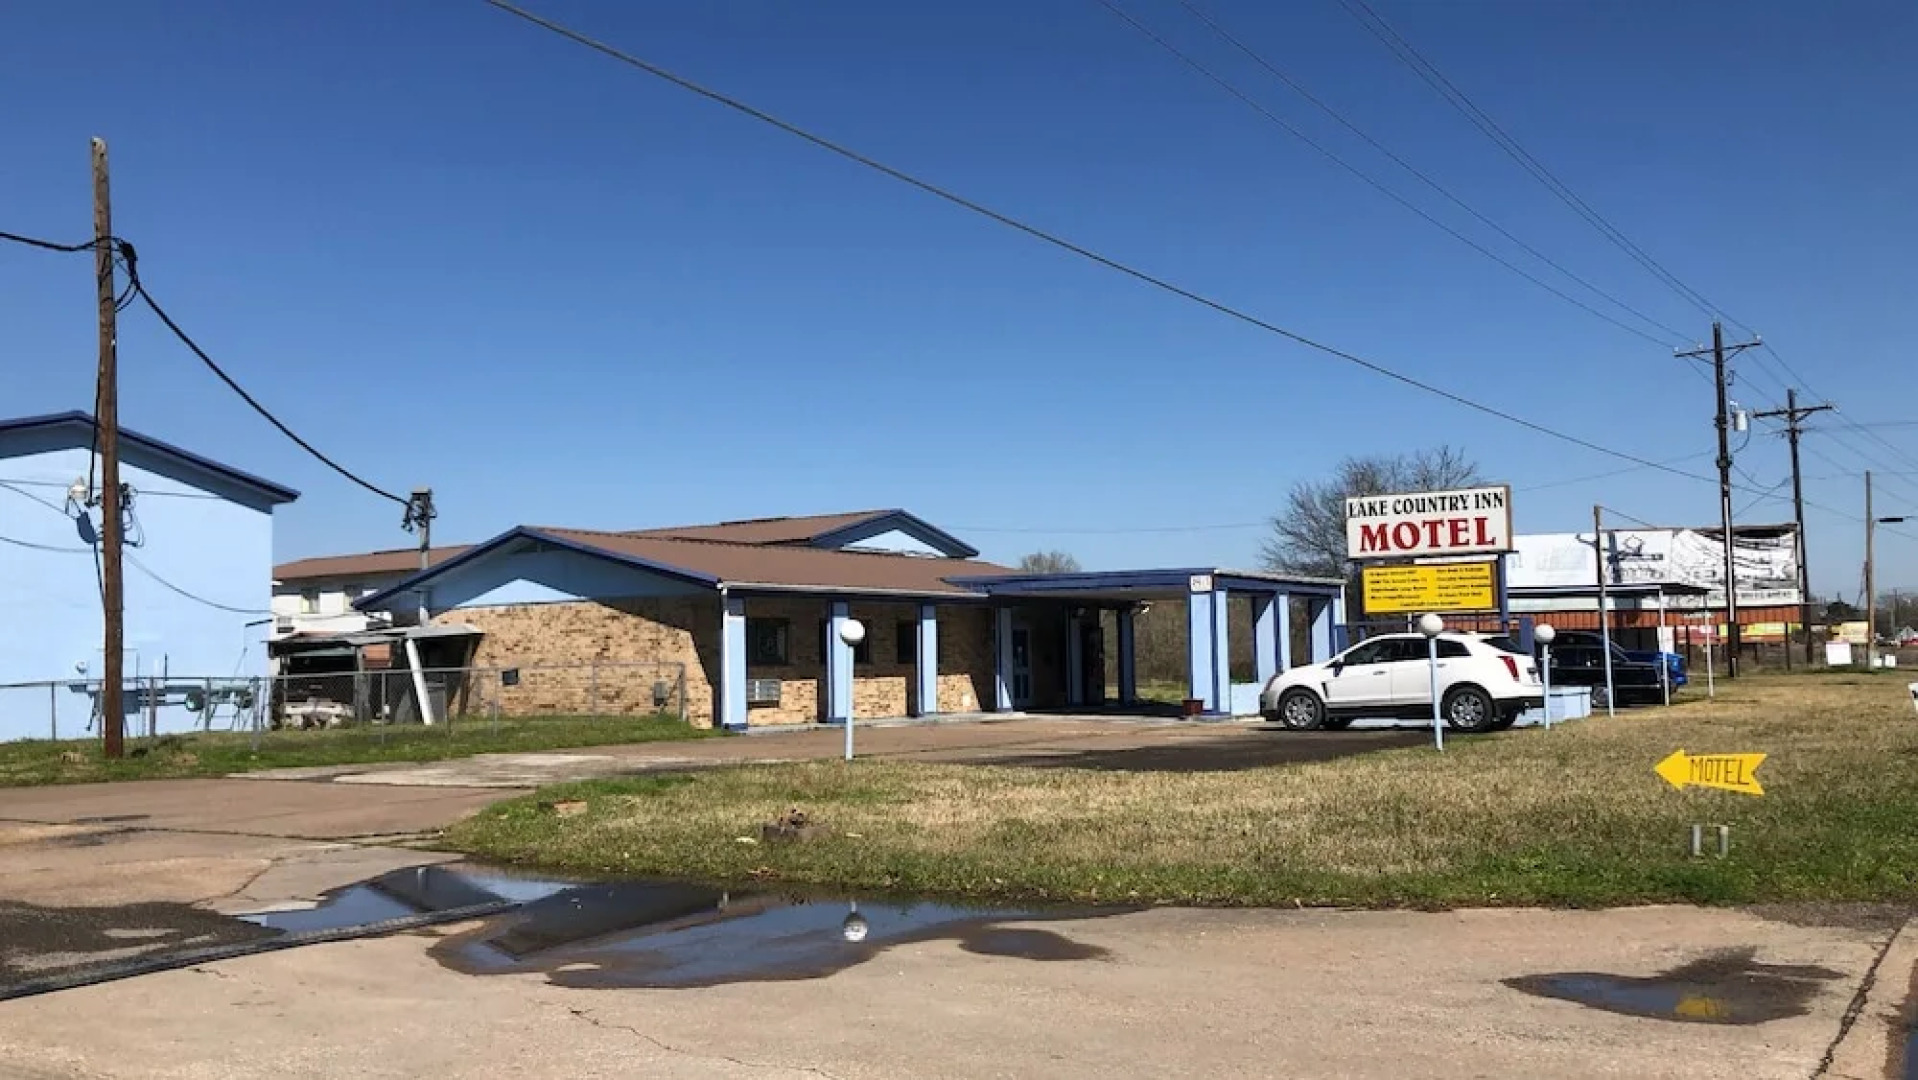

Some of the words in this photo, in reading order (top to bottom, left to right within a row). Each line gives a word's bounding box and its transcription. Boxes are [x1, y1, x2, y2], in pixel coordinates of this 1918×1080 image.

[1348, 499, 1388, 519] LAKE
[1392, 494, 1470, 515] COUNTRY
[1474, 492, 1504, 509] INN
[1359, 516, 1497, 553] MOTEL
[1689, 757, 1750, 786] MOTEL
